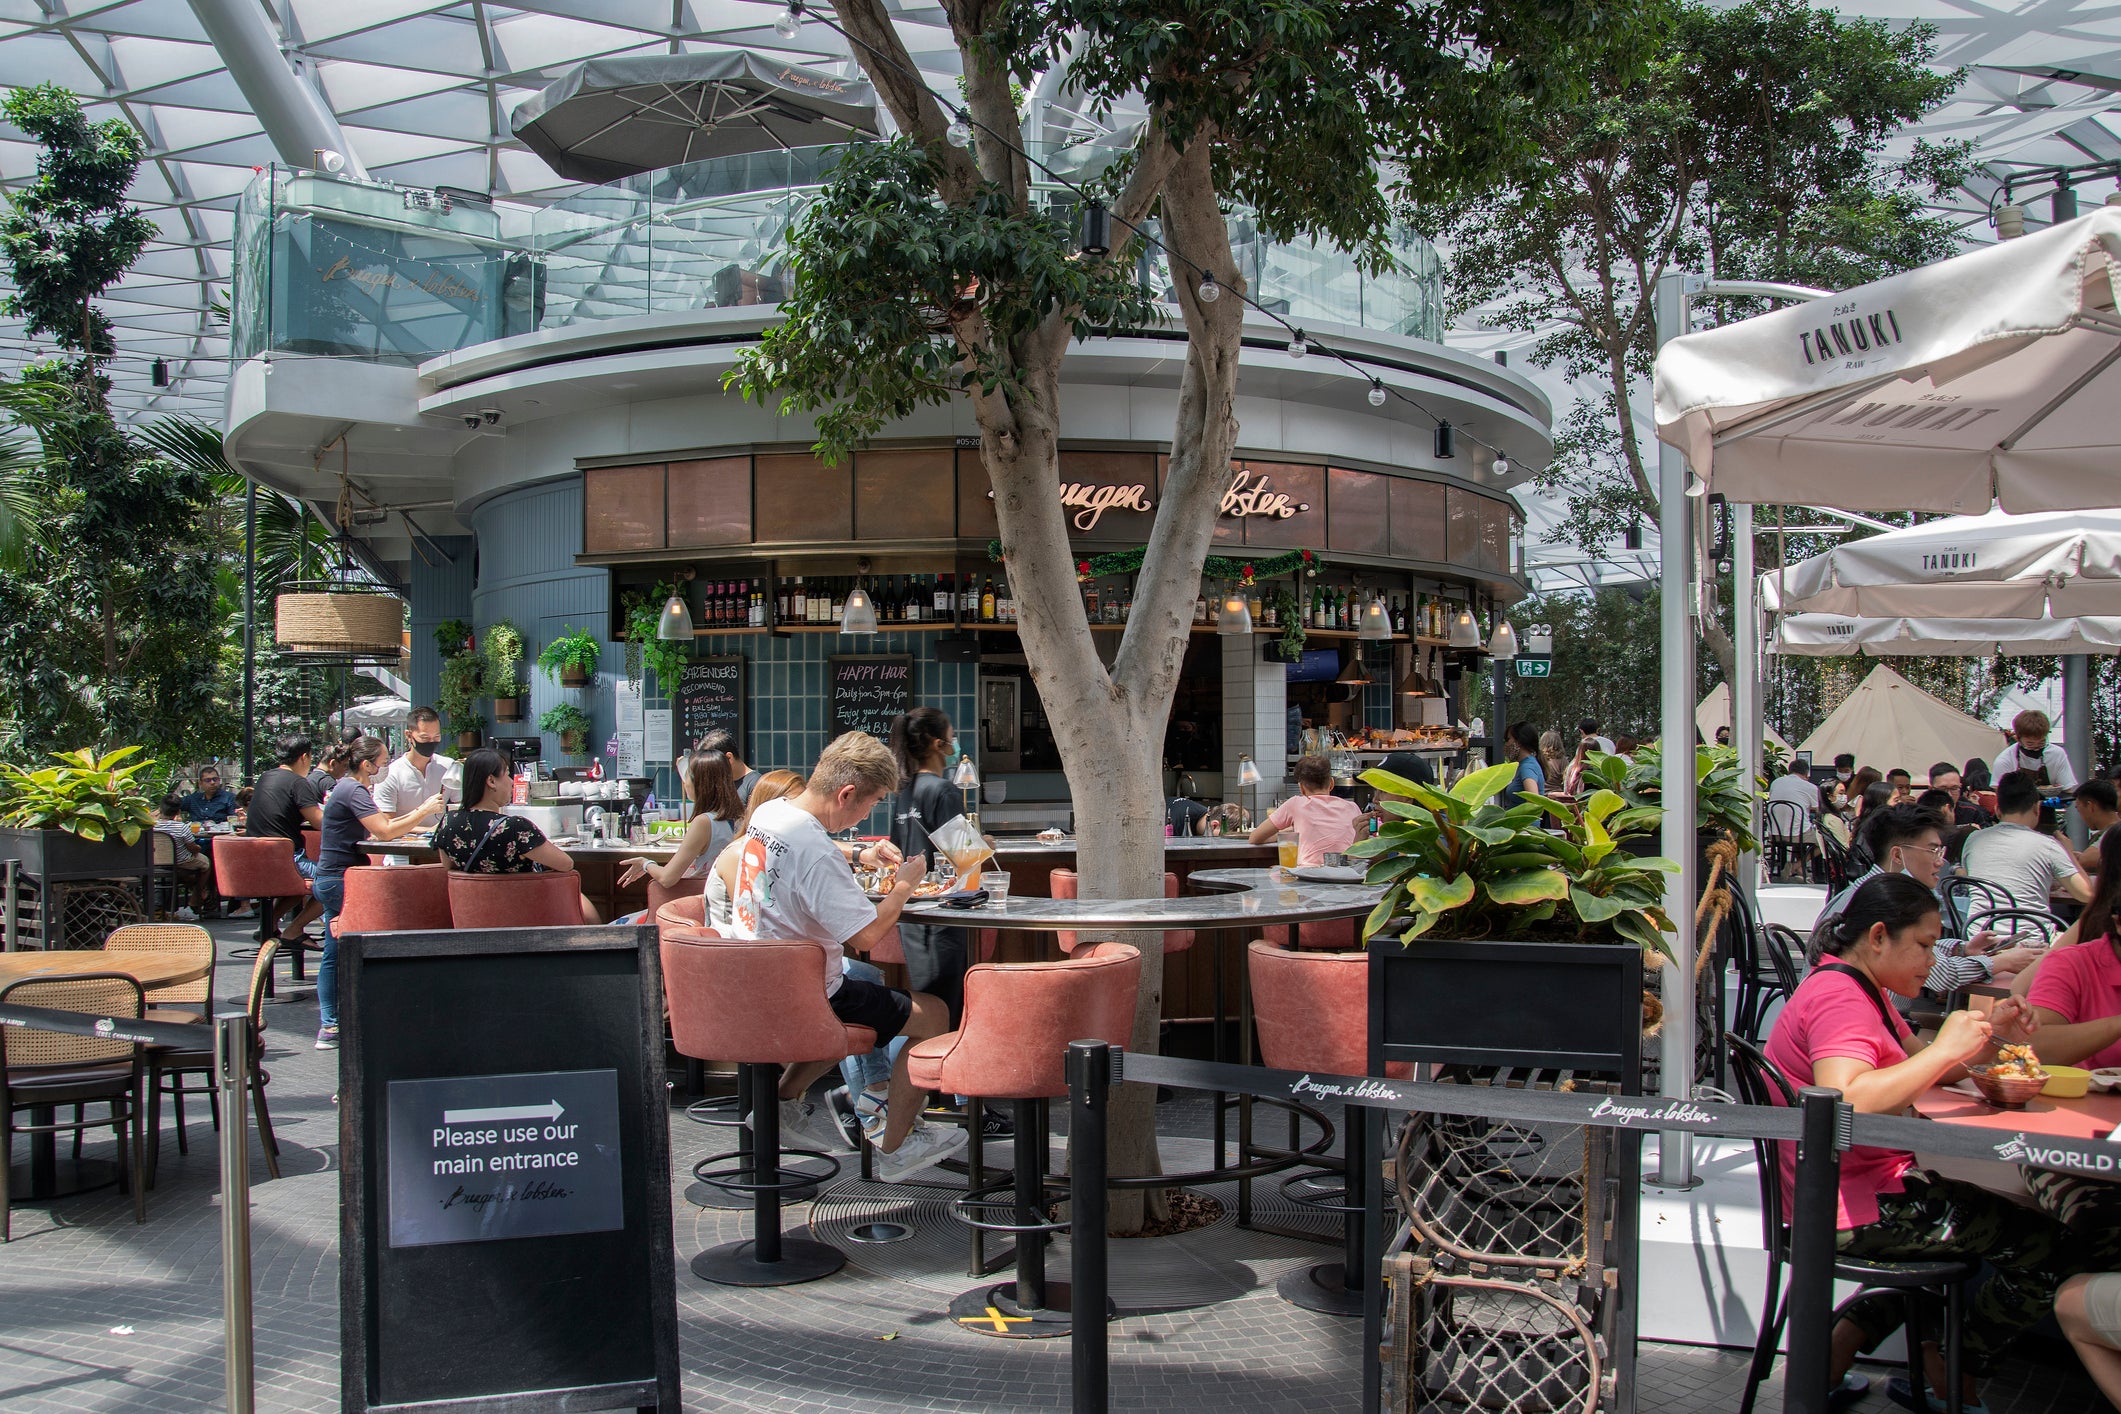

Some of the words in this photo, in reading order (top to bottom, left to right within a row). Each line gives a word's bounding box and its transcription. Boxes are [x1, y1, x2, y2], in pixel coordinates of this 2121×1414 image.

[1833, 302, 1856, 317] たぬき
[1800, 309, 1902, 365] TANUKI
[1845, 359, 1866, 370] RAW
[1059, 481, 1152, 531] urger
[1221, 468, 1296, 520] bster
[1922, 552, 1976, 570] TANUKI
[1826, 625, 1854, 636] TANUKI
[681, 664, 738, 680] BARTENDERS
[837, 665, 879, 680] HAPPY
[880, 665, 908, 680] HOUR
[681, 682, 726, 695] RECOMMEND
[835, 686, 858, 702] Daily
[836, 705, 860, 725] Enjoy
[861, 708, 879, 723] your
[1292, 1074, 1343, 1100] Burger
[1343, 1086, 1355, 1096] &
[1355, 1079, 1397, 1100] lobster
[1592, 1096, 1649, 1124] Burger
[1651, 1108, 1663, 1119] &
[1664, 1101, 1711, 1124] lobster
[433, 1127, 498, 1148] Please
[503, 1127, 538, 1143] use
[543, 1124, 579, 1141] our
[434, 1154, 484, 1175] main
[490, 1151, 579, 1171] entrance
[1999, 1143, 2021, 1158] THE
[2025, 1146, 2114, 1171] WORLD
[520, 1181, 568, 1201] lobster
